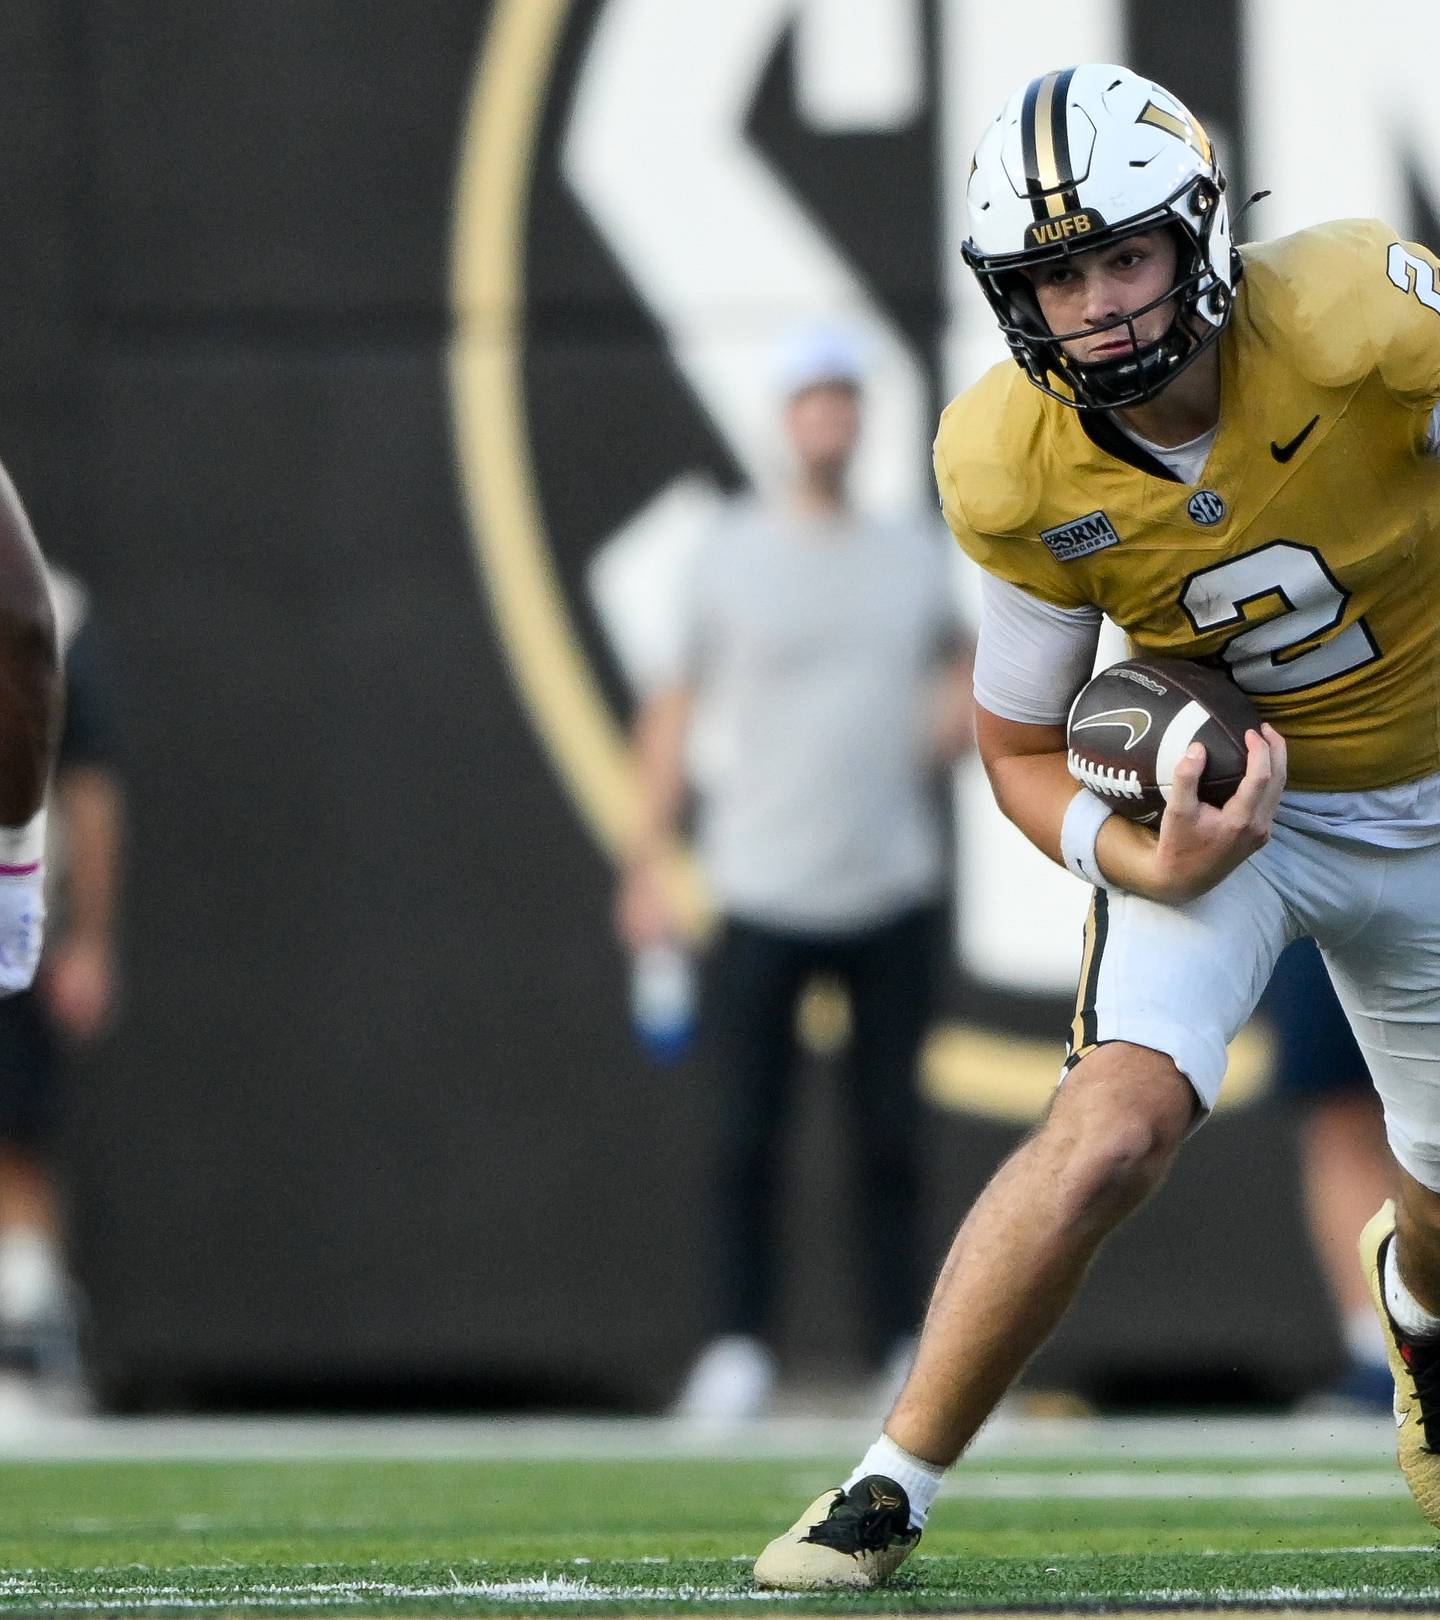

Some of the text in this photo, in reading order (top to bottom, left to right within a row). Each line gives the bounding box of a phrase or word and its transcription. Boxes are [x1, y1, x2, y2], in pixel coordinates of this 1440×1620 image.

[1032, 214, 1091, 245] VUFB
[1189, 492, 1222, 523] SEC
[1050, 516, 1110, 550] SRM
[1176, 538, 1384, 696] 2
